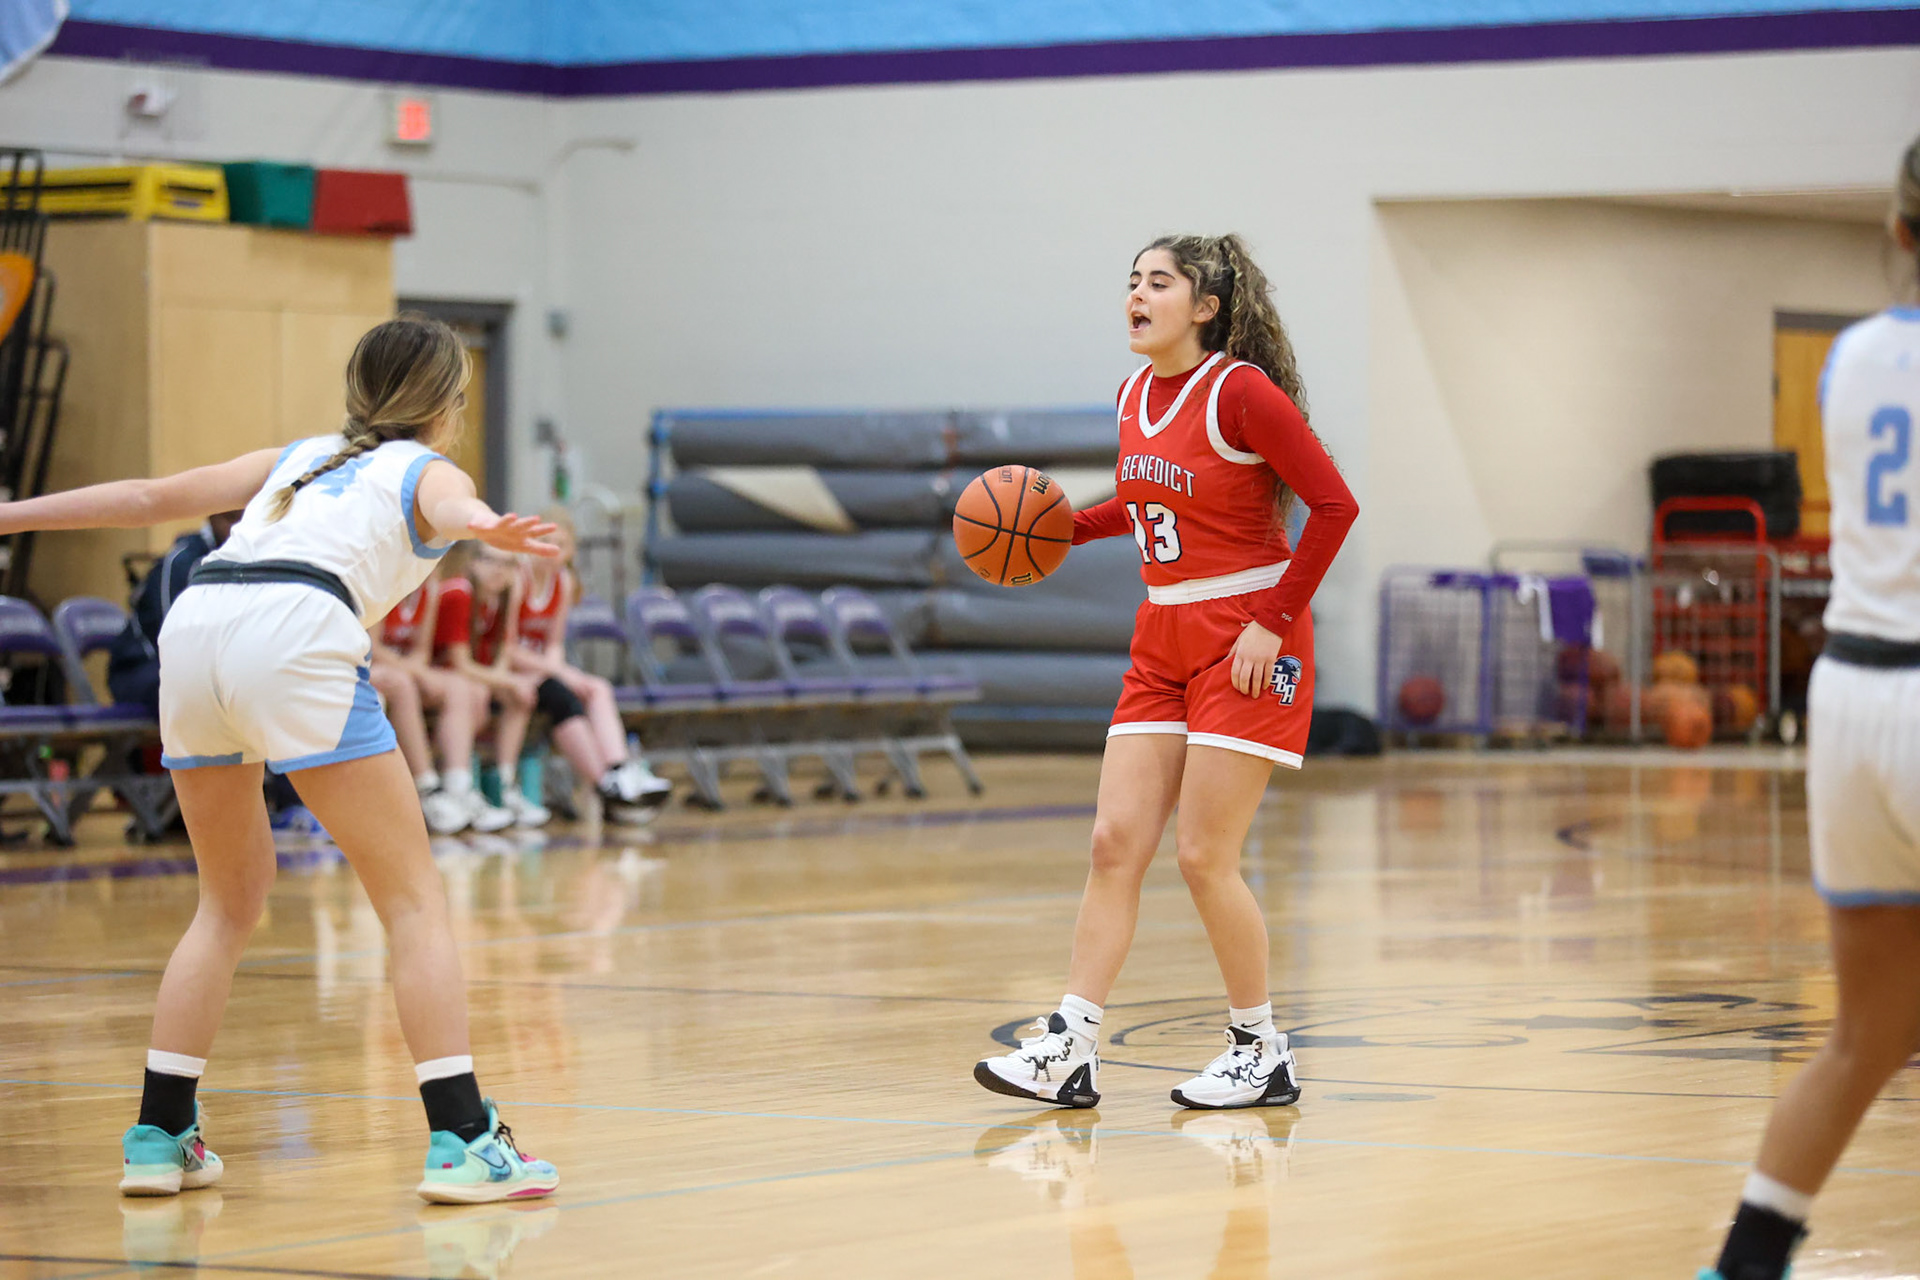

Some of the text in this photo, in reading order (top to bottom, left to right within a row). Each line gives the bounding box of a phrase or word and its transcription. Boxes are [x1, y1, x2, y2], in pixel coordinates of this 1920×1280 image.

[1121, 454, 1195, 498] BENEDICT
[1866, 406, 1912, 526] 2
[1125, 502, 1182, 564] 13
